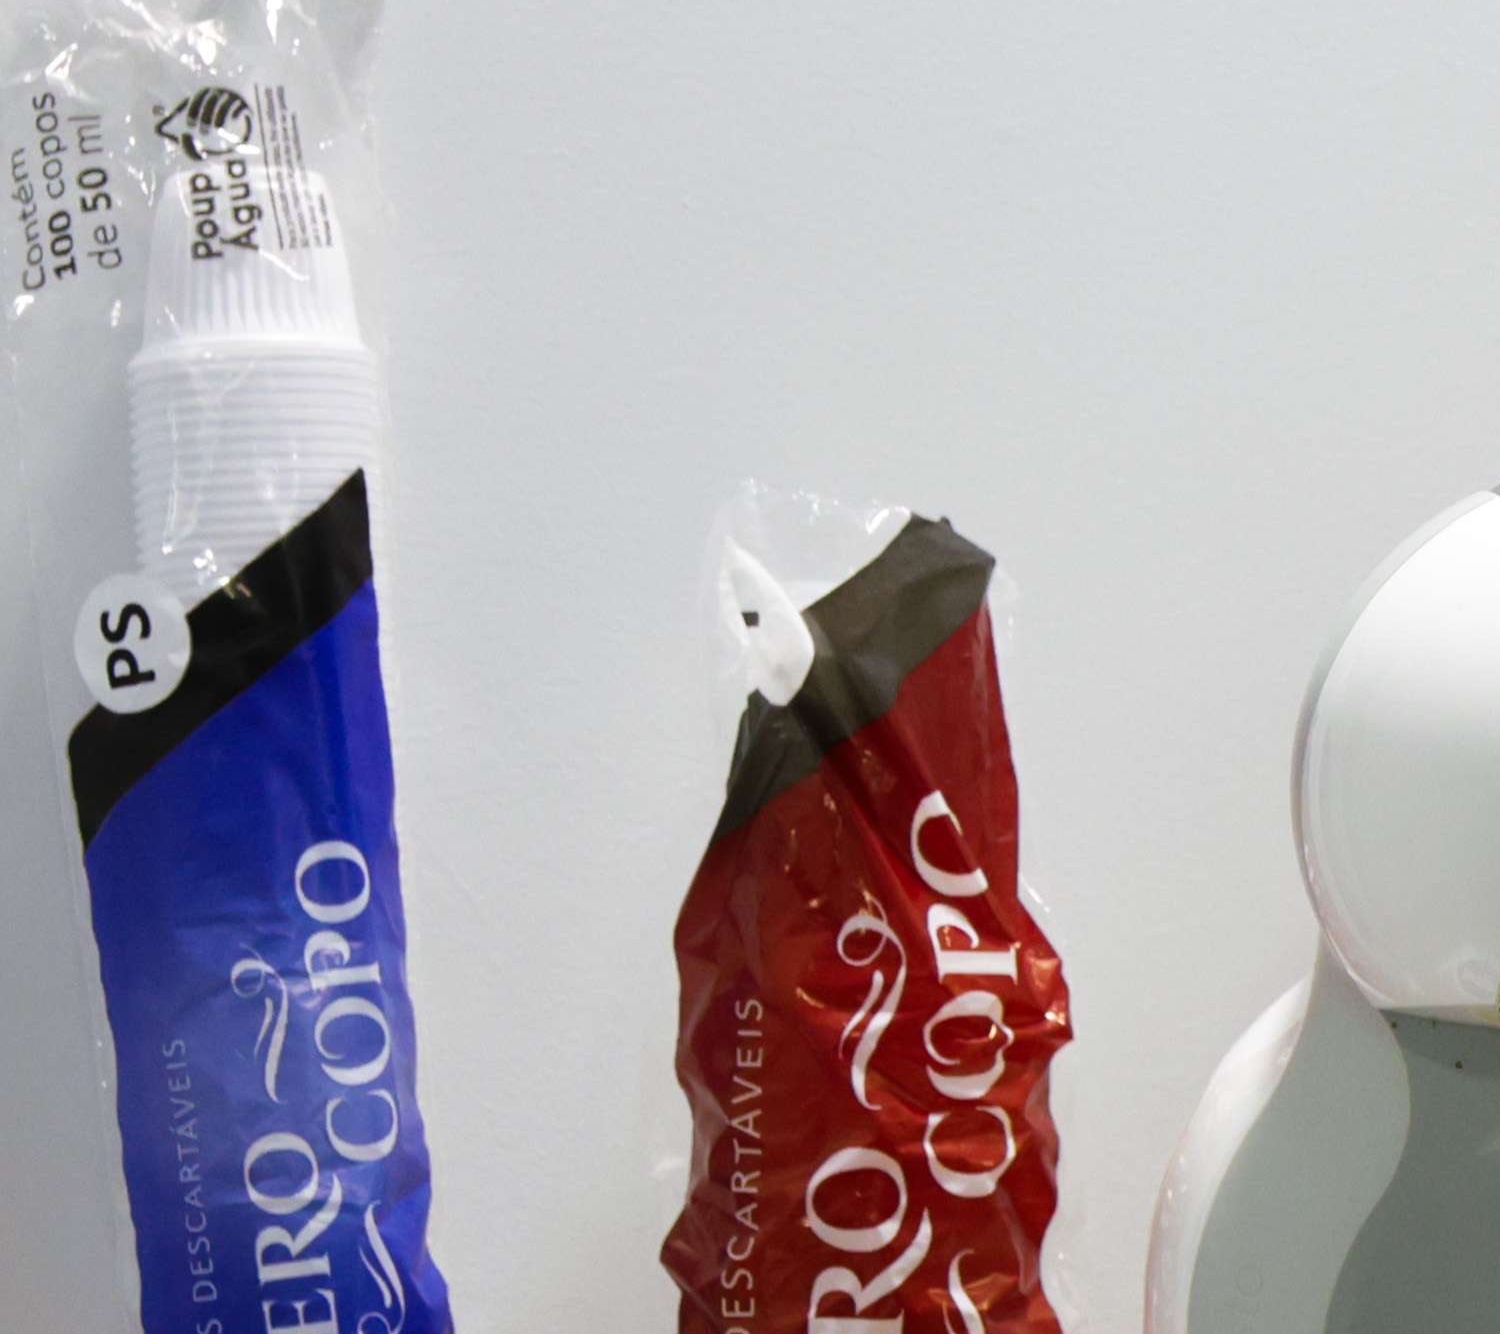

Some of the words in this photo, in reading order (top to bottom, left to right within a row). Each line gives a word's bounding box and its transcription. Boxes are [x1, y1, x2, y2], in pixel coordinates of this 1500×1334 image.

[32, 92, 68, 199] copos
[67, 114, 103, 156] ml
[11, 147, 46, 291] Contém
[76, 166, 113, 212] 50
[189, 172, 226, 261] Poup
[220, 158, 263, 251] Água
[48, 210, 78, 281] 100
[87, 223, 123, 270] de
[100, 602, 157, 691] PS
[294, 840, 399, 1163] COPO
[161, 1038, 219, 1304] DESCARTÁVEIS
